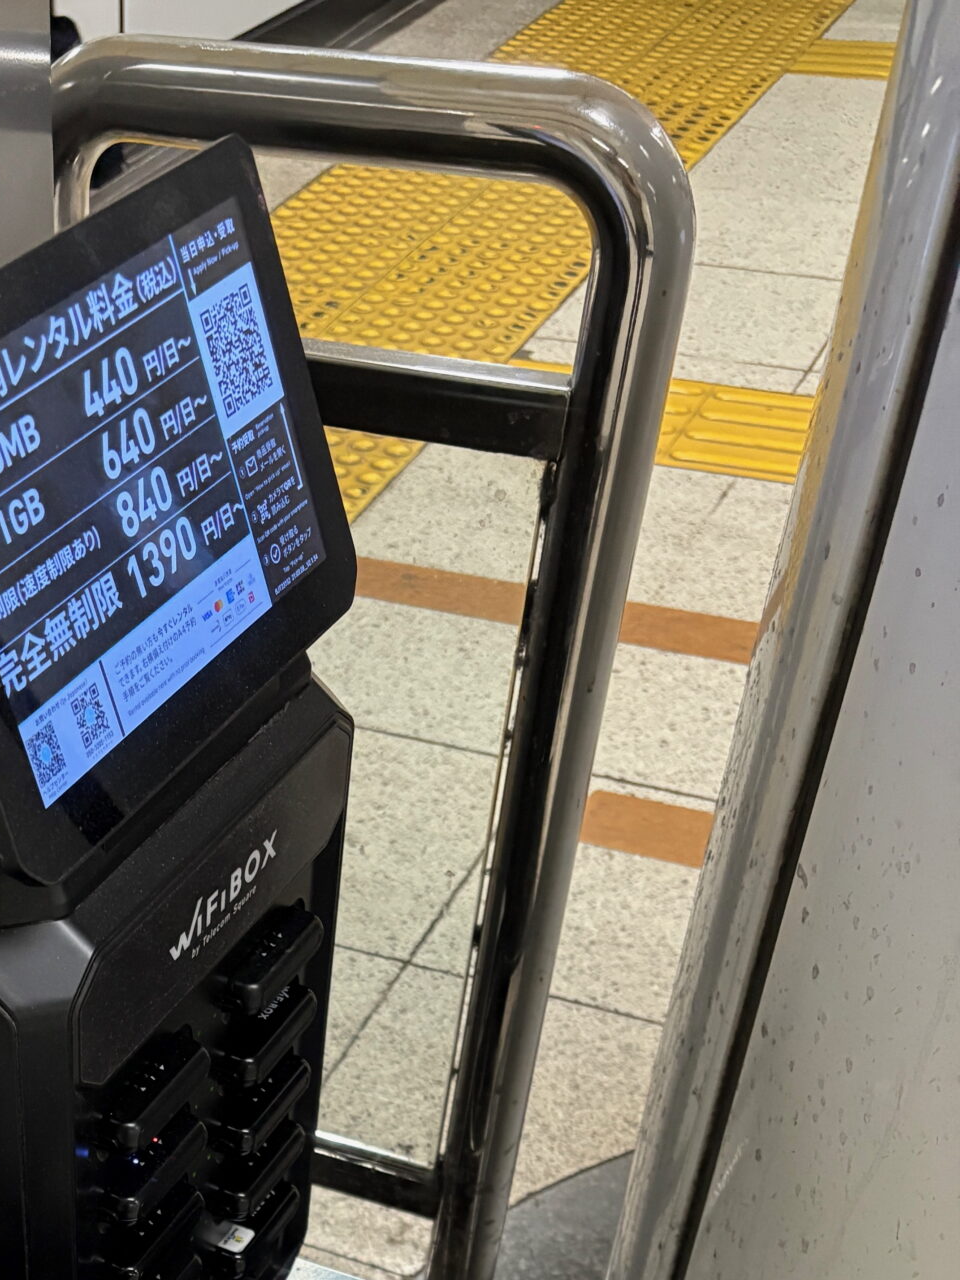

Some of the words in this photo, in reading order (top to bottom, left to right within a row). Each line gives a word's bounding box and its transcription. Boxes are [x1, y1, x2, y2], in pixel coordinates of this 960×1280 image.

[179, 217, 236, 264] 当日申込・受取
[83, 346, 138, 418] 440
[101, 407, 156, 480] 640
[115, 465, 173, 538] 840
[126, 515, 197, 599] 1390
[202, 913, 231, 945] Telecom
[232, 885, 257, 915] Square
